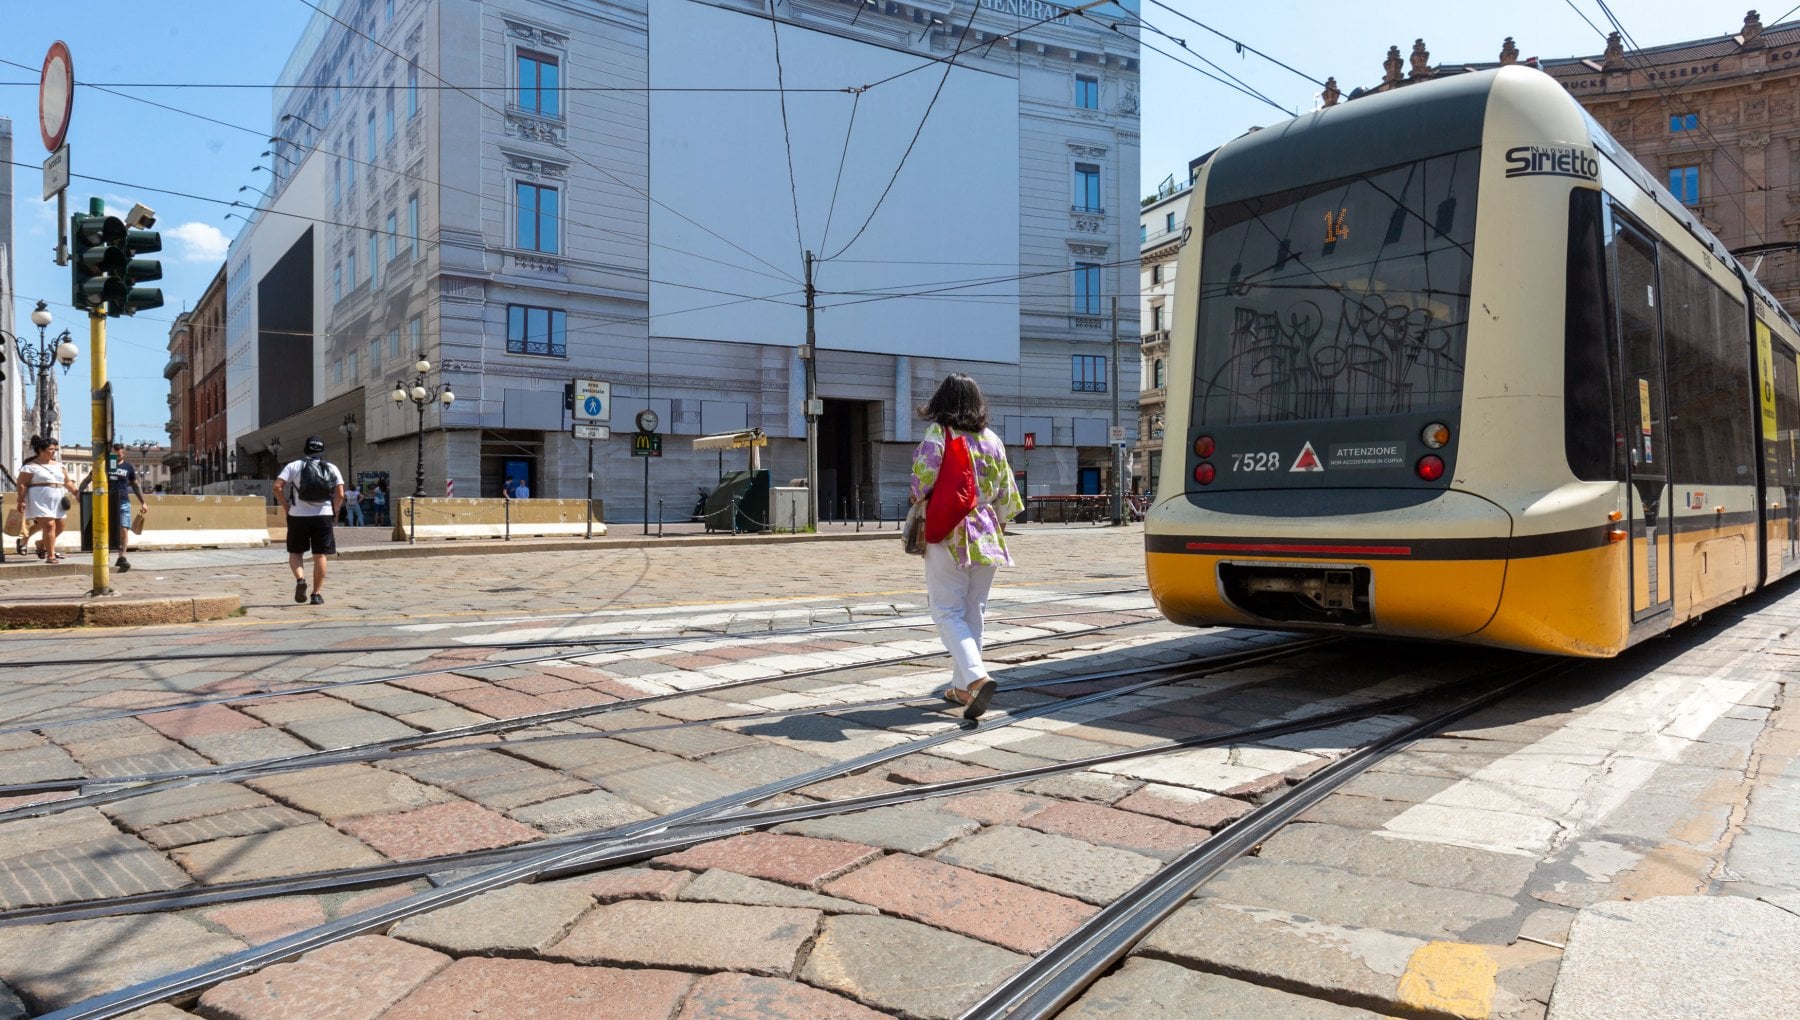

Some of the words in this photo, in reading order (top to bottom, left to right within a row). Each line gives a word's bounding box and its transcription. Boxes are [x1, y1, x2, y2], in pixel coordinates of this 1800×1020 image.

[980, 0, 1070, 25] GENERALI
[1648, 63, 1719, 81] RESERVE
[1323, 208, 1350, 243] 14
[1025, 436, 1033, 447] M
[1336, 446, 1398, 457] ATTENZIONE
[1231, 451, 1280, 472] 7528
